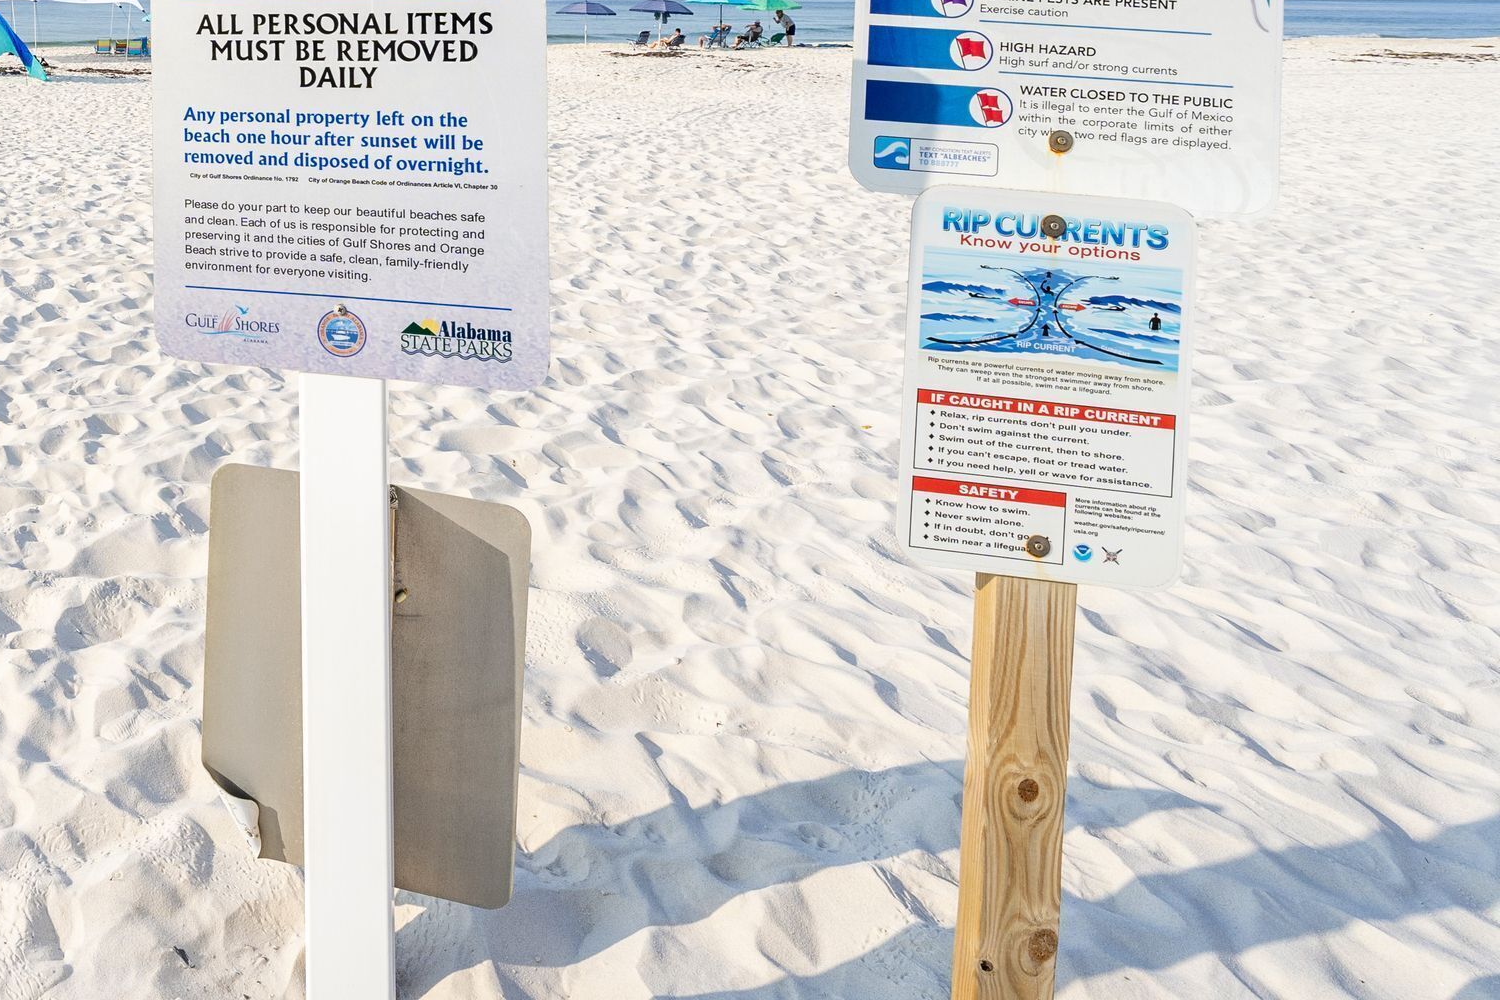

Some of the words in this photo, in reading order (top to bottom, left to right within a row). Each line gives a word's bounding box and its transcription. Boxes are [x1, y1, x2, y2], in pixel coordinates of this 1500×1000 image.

[979, 3, 1025, 15] Exercise
[1027, 7, 1068, 18] caution
[195, 13, 244, 35] ALL
[252, 12, 399, 35] PERSONAL
[406, 11, 493, 35] ITEMS
[210, 39, 286, 61] MUST
[295, 39, 327, 61] BE
[336, 39, 479, 62] REMOVED
[999, 41, 1034, 53] HIGH
[1038, 43, 1097, 57] HAZARD
[999, 55, 1025, 69] High
[1028, 57, 1049, 67] surf
[1051, 59, 1090, 70] and/or
[1092, 63, 1128, 76] strong
[1131, 66, 1178, 76] currents
[299, 66, 378, 89] DAILY
[1019, 84, 1067, 98] WATER
[1069, 88, 1126, 102] CLOSED
[1128, 92, 1149, 103] TO
[1151, 93, 1180, 106] THE
[1183, 95, 1233, 109] PUBLIC
[183, 106, 216, 124] Any
[220, 108, 290, 125] personal
[296, 112, 370, 128] property
[376, 110, 405, 126] left
[411, 115, 433, 127] on
[439, 111, 468, 128] the
[1017, 112, 1052, 123] within
[1057, 114, 1076, 126] the
[1081, 119, 1138, 130] corporate
[1143, 120, 1175, 133] limits
[1179, 123, 1194, 133] of
[1198, 125, 1233, 136] either
[184, 127, 230, 143] beach
[236, 132, 266, 144] one
[270, 129, 311, 146] hour
[314, 131, 355, 147] after
[360, 135, 417, 149] sunset
[423, 134, 455, 150] will
[462, 134, 483, 151] be
[1017, 125, 1038, 139] city
[1073, 130, 1095, 143] two
[1097, 131, 1118, 142] red
[1119, 131, 1148, 146] flags
[1150, 137, 1169, 146] are
[1171, 136, 1232, 151] displayed.
[184, 151, 253, 165] removed
[258, 152, 288, 167] and
[293, 152, 369, 171] disposed
[373, 155, 392, 170] of
[396, 156, 489, 176] overnight.
[919, 151, 938, 159] TEXT
[189, 172, 201, 180] City
[184, 198, 219, 210] Please
[220, 200, 235, 211] do
[237, 203, 263, 213] your
[265, 203, 287, 214] part
[289, 204, 300, 214] to
[303, 204, 331, 217] keep
[332, 207, 352, 216] our
[355, 206, 406, 219] beautiful
[409, 209, 458, 222] beaches
[460, 212, 486, 223] safe
[184, 215, 205, 225] and
[206, 215, 238, 226] clean.
[240, 216, 267, 228] Each
[269, 218, 281, 229] of
[283, 221, 297, 230] us
[299, 219, 309, 230] is
[311, 222, 377, 234] responsible
[379, 223, 396, 235] for
[398, 226, 459, 241] protecting
[461, 229, 485, 240] and
[942, 205, 991, 234] RIP
[994, 210, 1170, 250] CURENTS
[959, 233, 1013, 249] Know
[1018, 240, 1062, 254] your
[1067, 245, 1141, 261] options
[184, 260, 253, 273] environment
[254, 263, 271, 274] for
[273, 267, 326, 279] everyone
[327, 268, 372, 283] visiting.
[185, 312, 219, 329] GULF
[235, 316, 280, 334] SHORES
[438, 320, 513, 343] Alabama
[400, 334, 452, 352] STATE
[456, 338, 513, 358] PARKS
[1016, 340, 1032, 349] RIP
[1034, 342, 1077, 353] CURRENT
[930, 392, 946, 406] IF
[949, 395, 1013, 411] CAUGHT
[1017, 401, 1034, 415] IN
[1037, 404, 1050, 415] A
[1053, 405, 1080, 417] RIP
[1084, 409, 1162, 426] CURRENT
[939, 410, 969, 421] Relax,
[971, 414, 985, 422] rip
[987, 416, 1028, 426] currents
[1030, 420, 1055, 429] don't
[1078, 426, 1098, 434] you
[1100, 428, 1131, 437] under.
[958, 484, 1019, 500] SAFETY
[934, 510, 964, 520] Never
[965, 515, 992, 523] swim
[993, 518, 1024, 527] alone.
[935, 498, 964, 508] Know
[965, 502, 987, 511] how
[1001, 507, 1031, 516] swim.
[932, 534, 959, 544] Swim
[933, 522, 941, 530] If
[942, 523, 953, 531] in
[954, 525, 986, 536] doubt,
[988, 529, 1015, 538] don't
[1016, 533, 1030, 543] go
